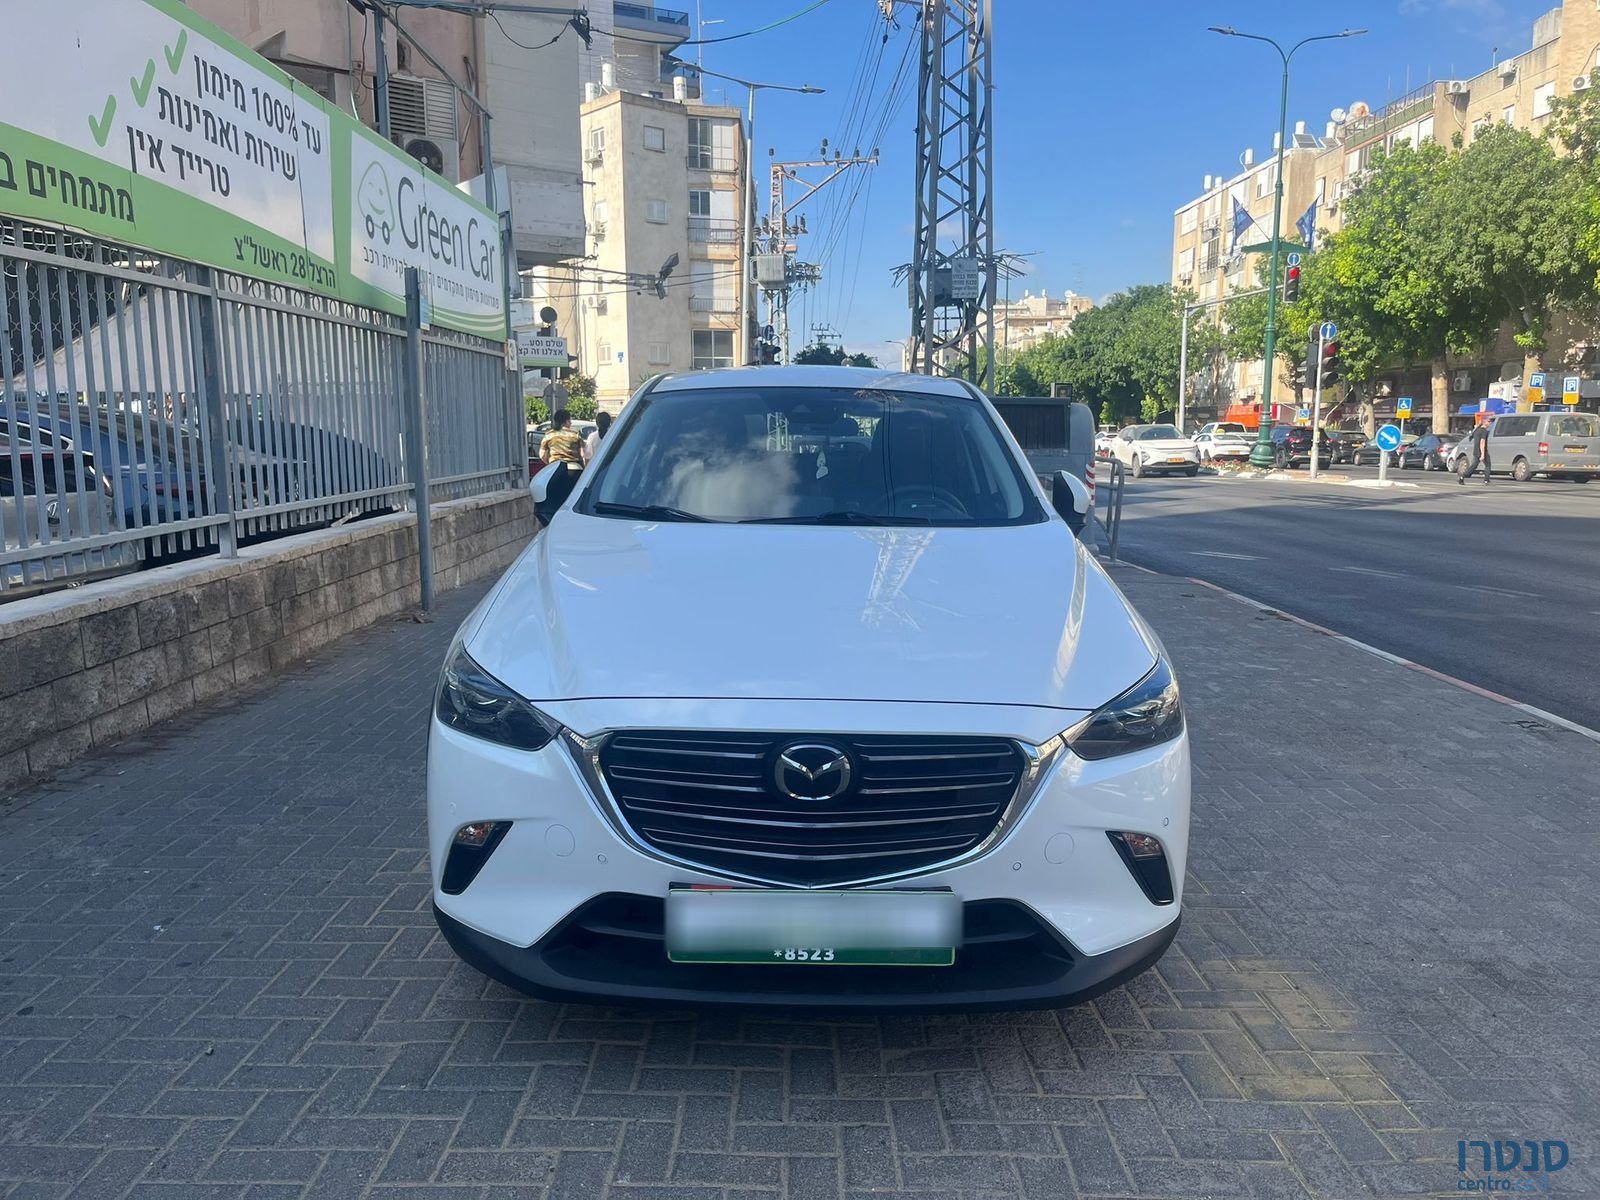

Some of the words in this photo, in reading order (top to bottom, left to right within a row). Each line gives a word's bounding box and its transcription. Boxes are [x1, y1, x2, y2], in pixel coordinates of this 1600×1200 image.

[194, 54, 247, 113] מימון
[157, 86, 239, 155] ואמינות
[251, 87, 299, 142] 100%
[301, 120, 321, 154] עד
[126, 125, 166, 174] אין
[171, 144, 230, 197] טרייד
[244, 130, 297, 181] שירות
[26, 159, 135, 222] מתמחים
[397, 176, 465, 271] Green
[467, 217, 495, 284] Car
[290, 252, 306, 279] 28
[308, 257, 336, 289] הרצל
[542, 347, 563, 356] אצלנו
[545, 339, 563, 347] שלם
